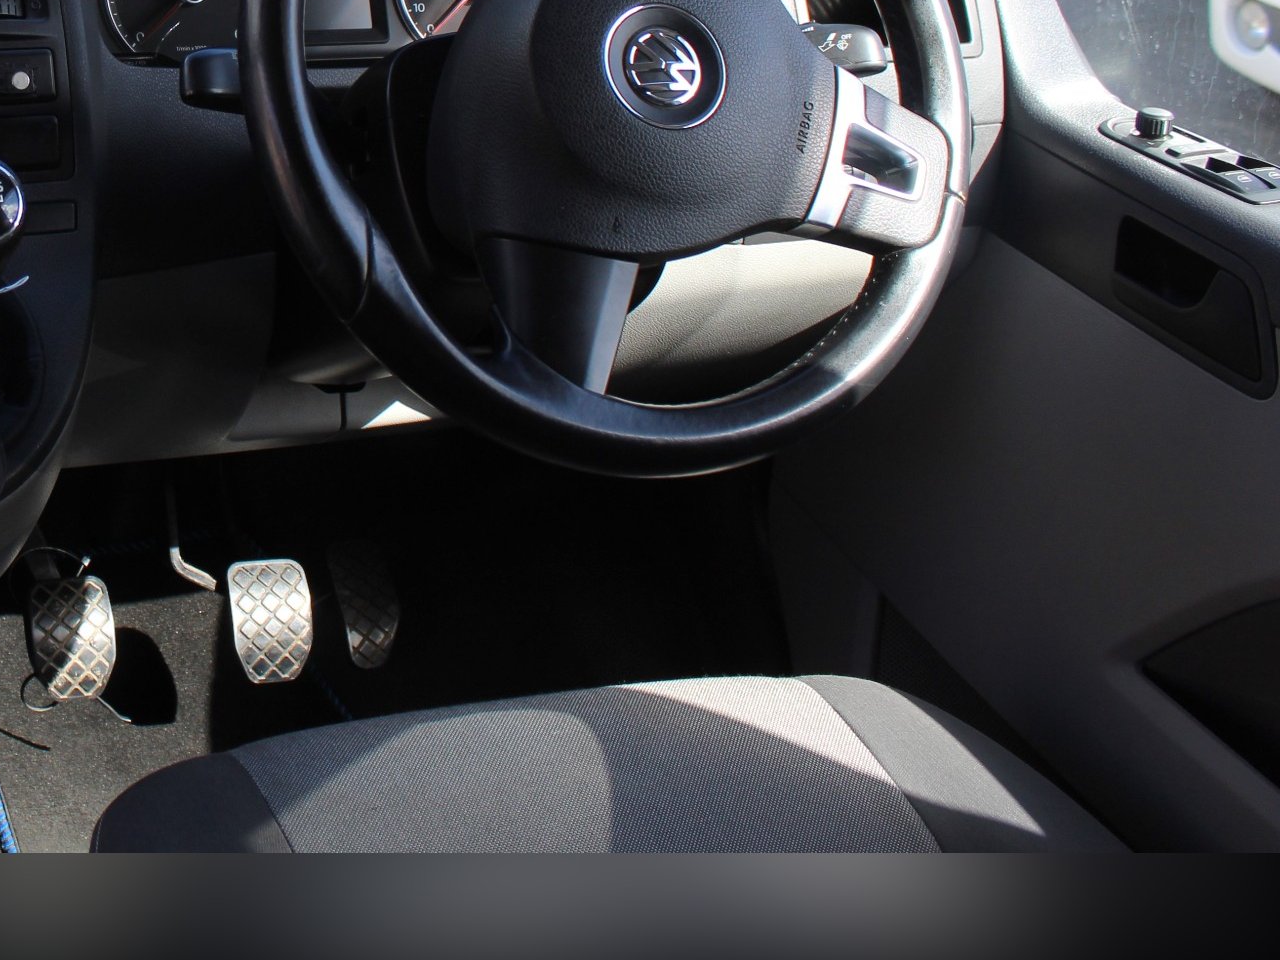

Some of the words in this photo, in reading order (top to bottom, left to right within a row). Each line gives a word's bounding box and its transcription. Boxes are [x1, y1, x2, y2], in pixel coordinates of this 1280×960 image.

[413, 3, 425, 13] 10
[427, 23, 435, 33] 0
[796, 101, 814, 154] AIRBAG
